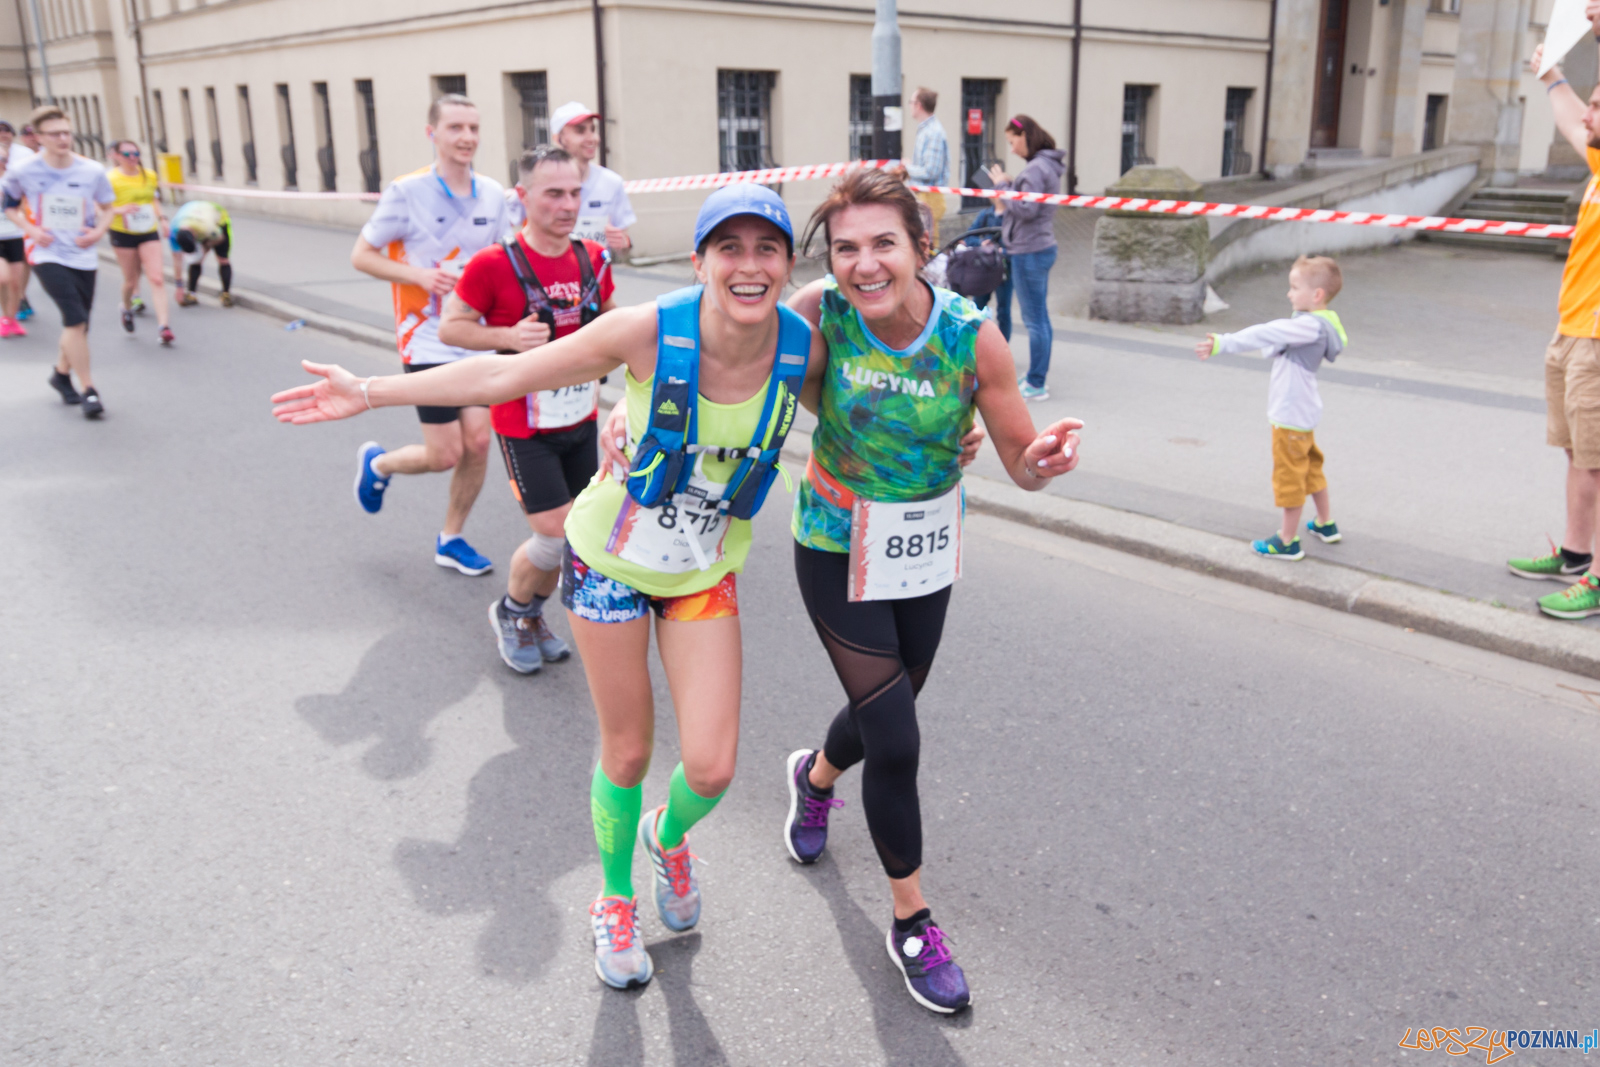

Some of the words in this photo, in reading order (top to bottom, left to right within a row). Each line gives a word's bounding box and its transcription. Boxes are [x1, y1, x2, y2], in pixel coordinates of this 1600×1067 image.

[842, 361, 935, 398] LUCYNA
[885, 525, 949, 559] 8815
[904, 561, 933, 570] Lucyna
